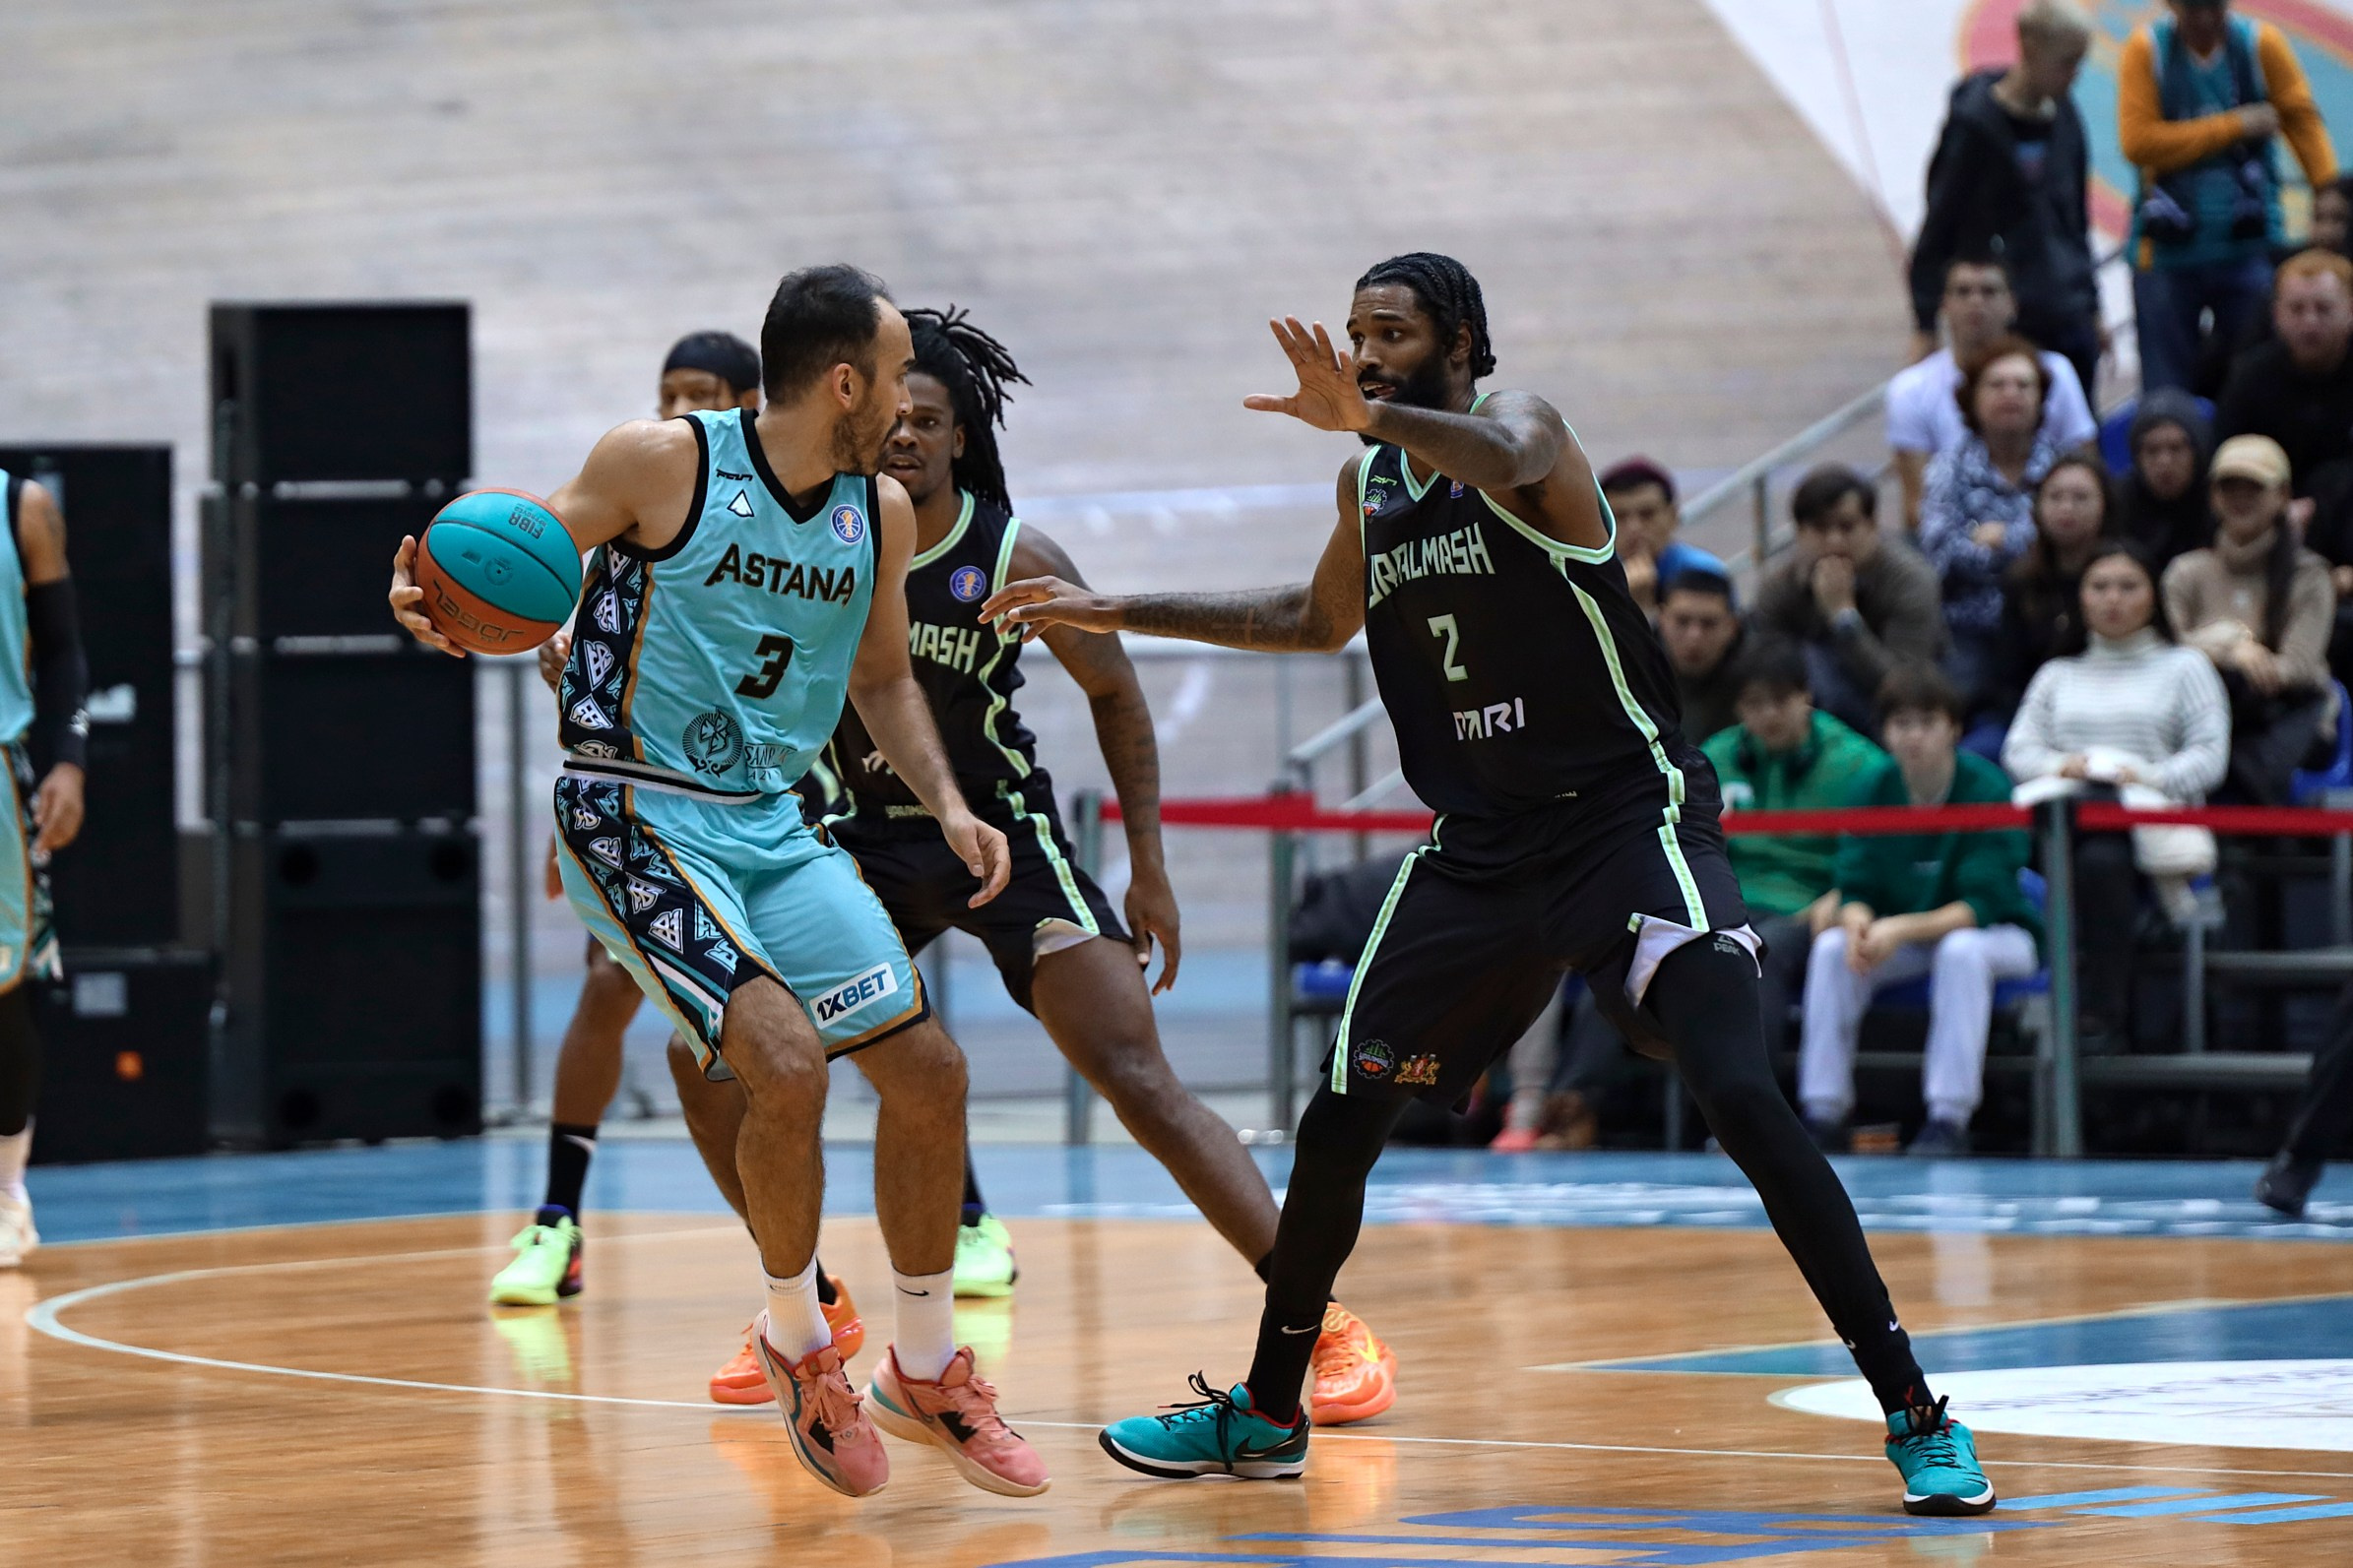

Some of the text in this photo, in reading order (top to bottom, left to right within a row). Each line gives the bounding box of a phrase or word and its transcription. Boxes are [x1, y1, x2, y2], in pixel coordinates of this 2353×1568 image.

[508, 512, 544, 539] FIBA
[703, 542, 855, 607] ASTANA
[733, 633, 795, 699] 3
[1427, 613, 1469, 681] 2
[1713, 942, 1741, 957] PEAK
[816, 969, 887, 1022] 1XBET
